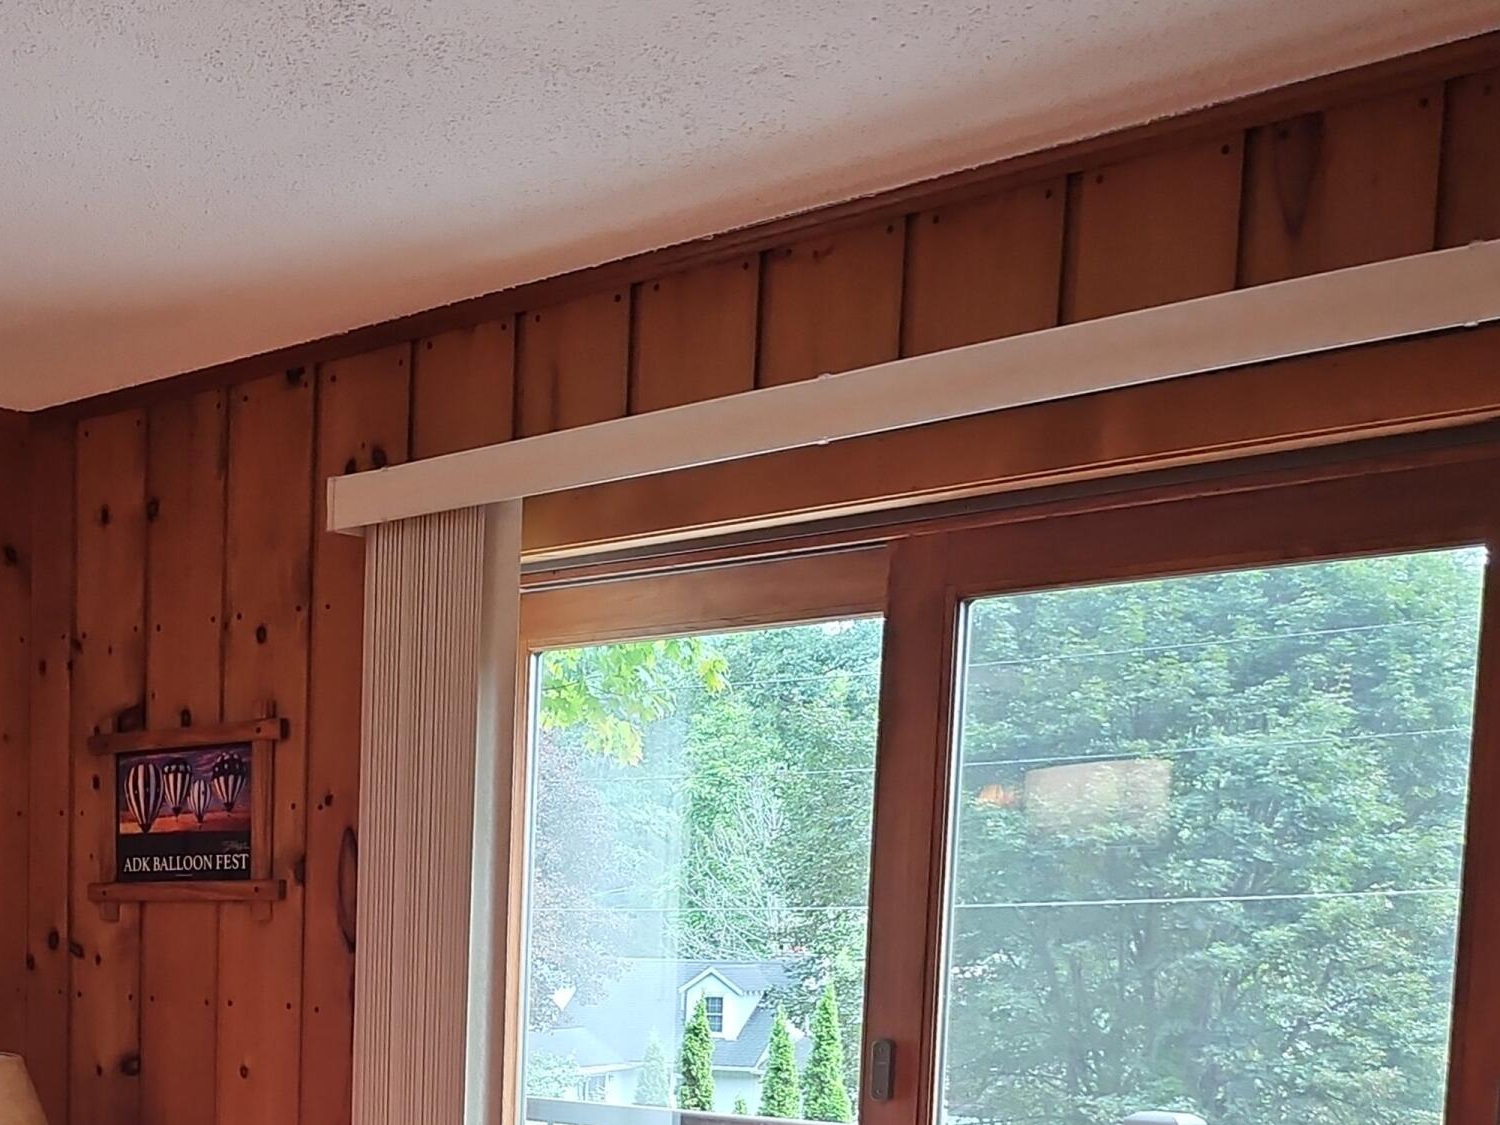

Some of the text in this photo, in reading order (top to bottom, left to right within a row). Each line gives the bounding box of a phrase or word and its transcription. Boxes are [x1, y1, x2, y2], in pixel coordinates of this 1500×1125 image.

[123, 853, 250, 873] ADK BALLOON FEST
